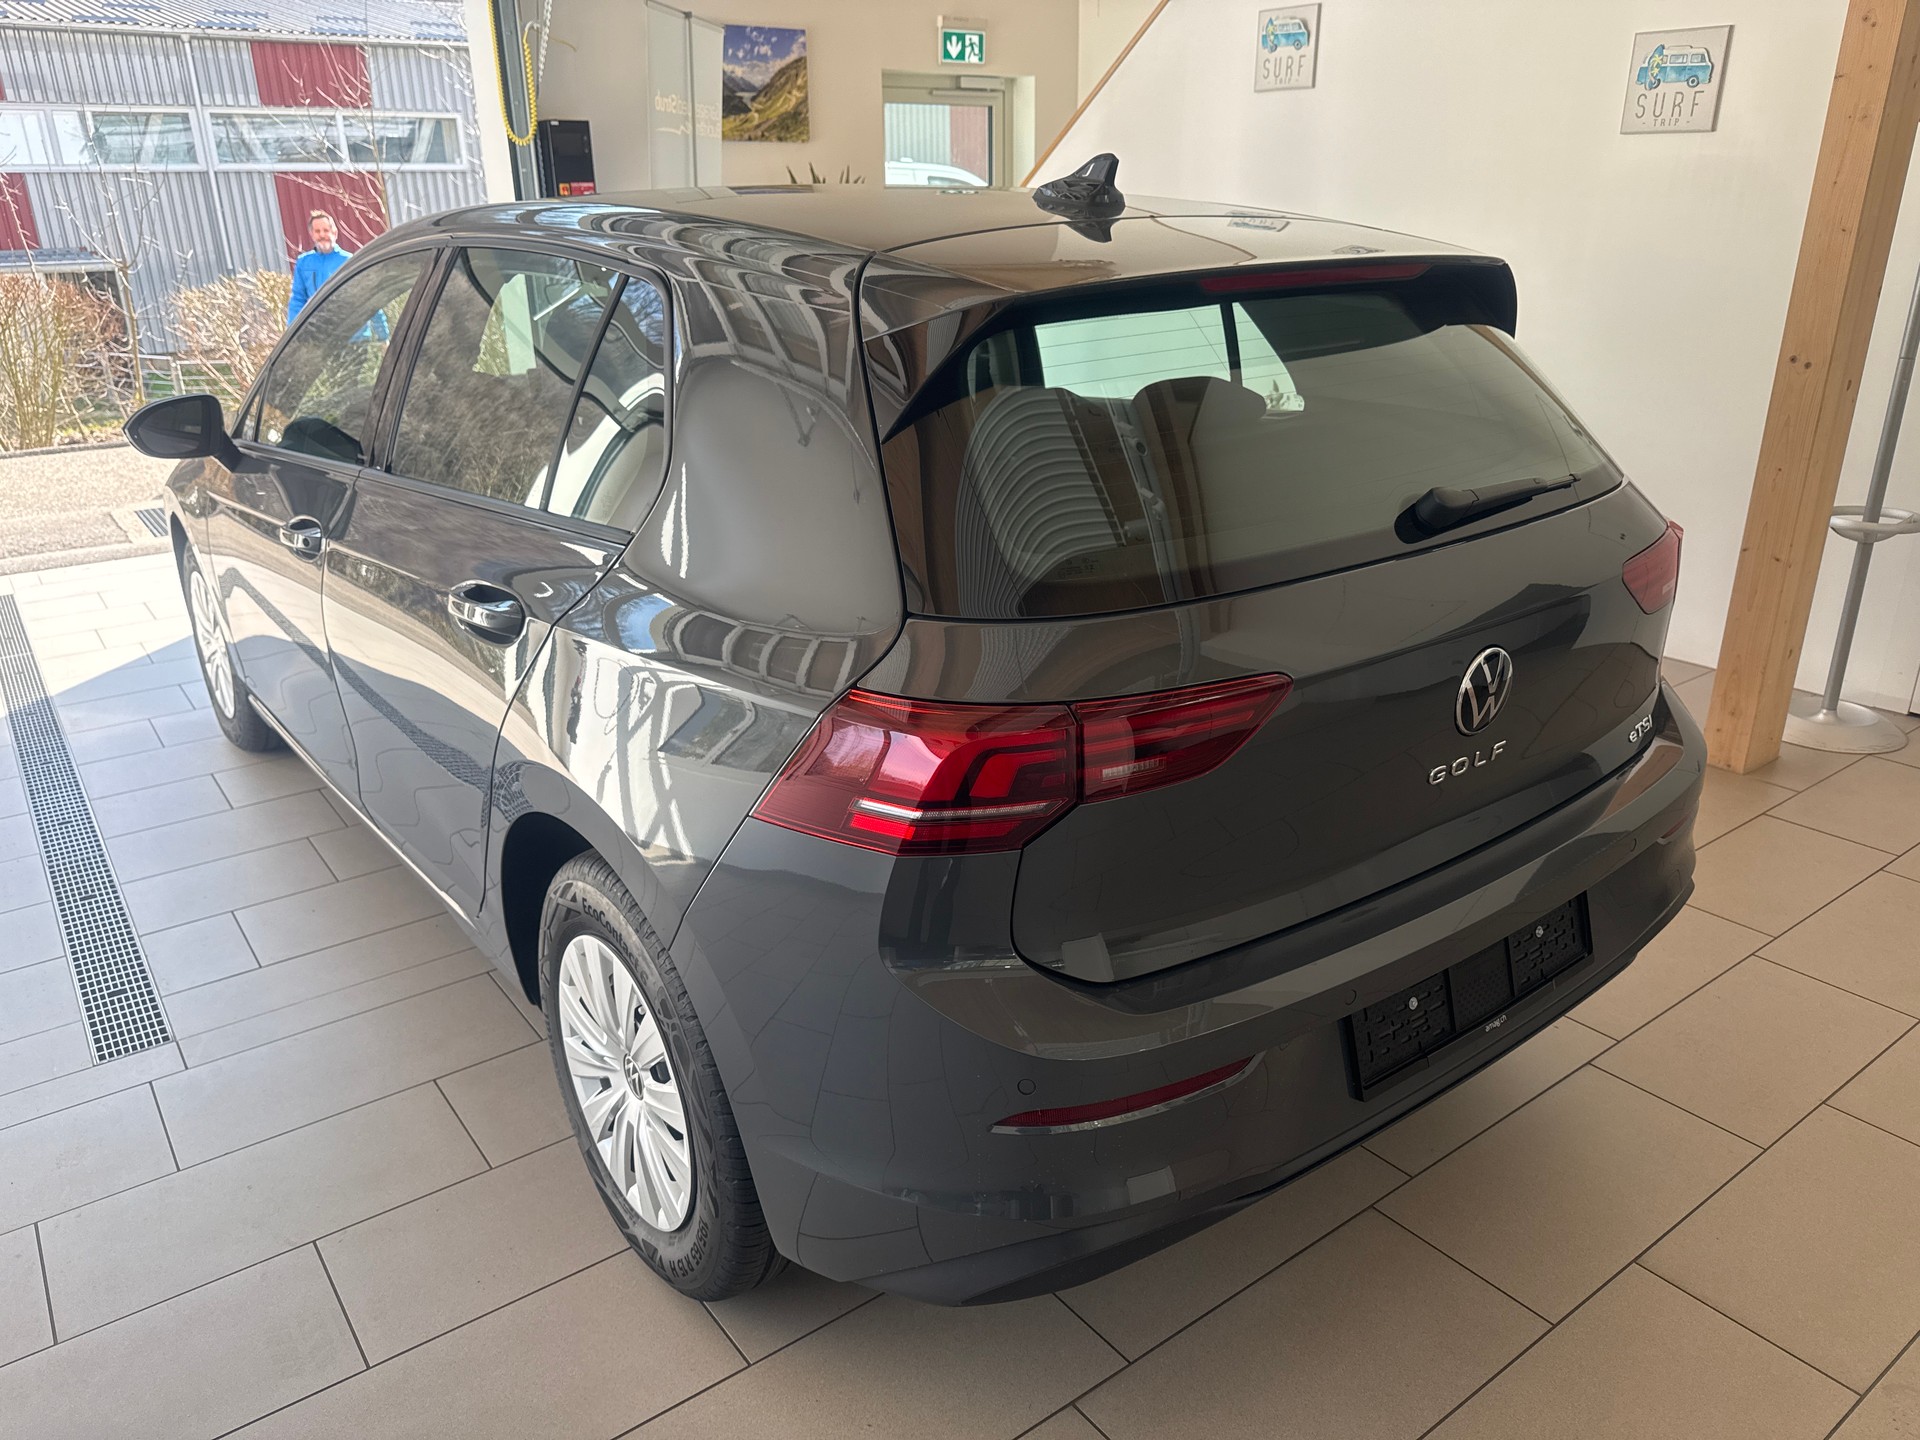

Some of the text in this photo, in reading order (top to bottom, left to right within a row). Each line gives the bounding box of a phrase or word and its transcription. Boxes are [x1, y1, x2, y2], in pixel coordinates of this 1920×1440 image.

[1263, 55, 1306, 80] SURF
[1635, 90, 1705, 119] SURF
[1653, 118, 1680, 127] TRIP
[1428, 740, 1507, 785] GOLF
[582, 897, 639, 973] EcoContact
